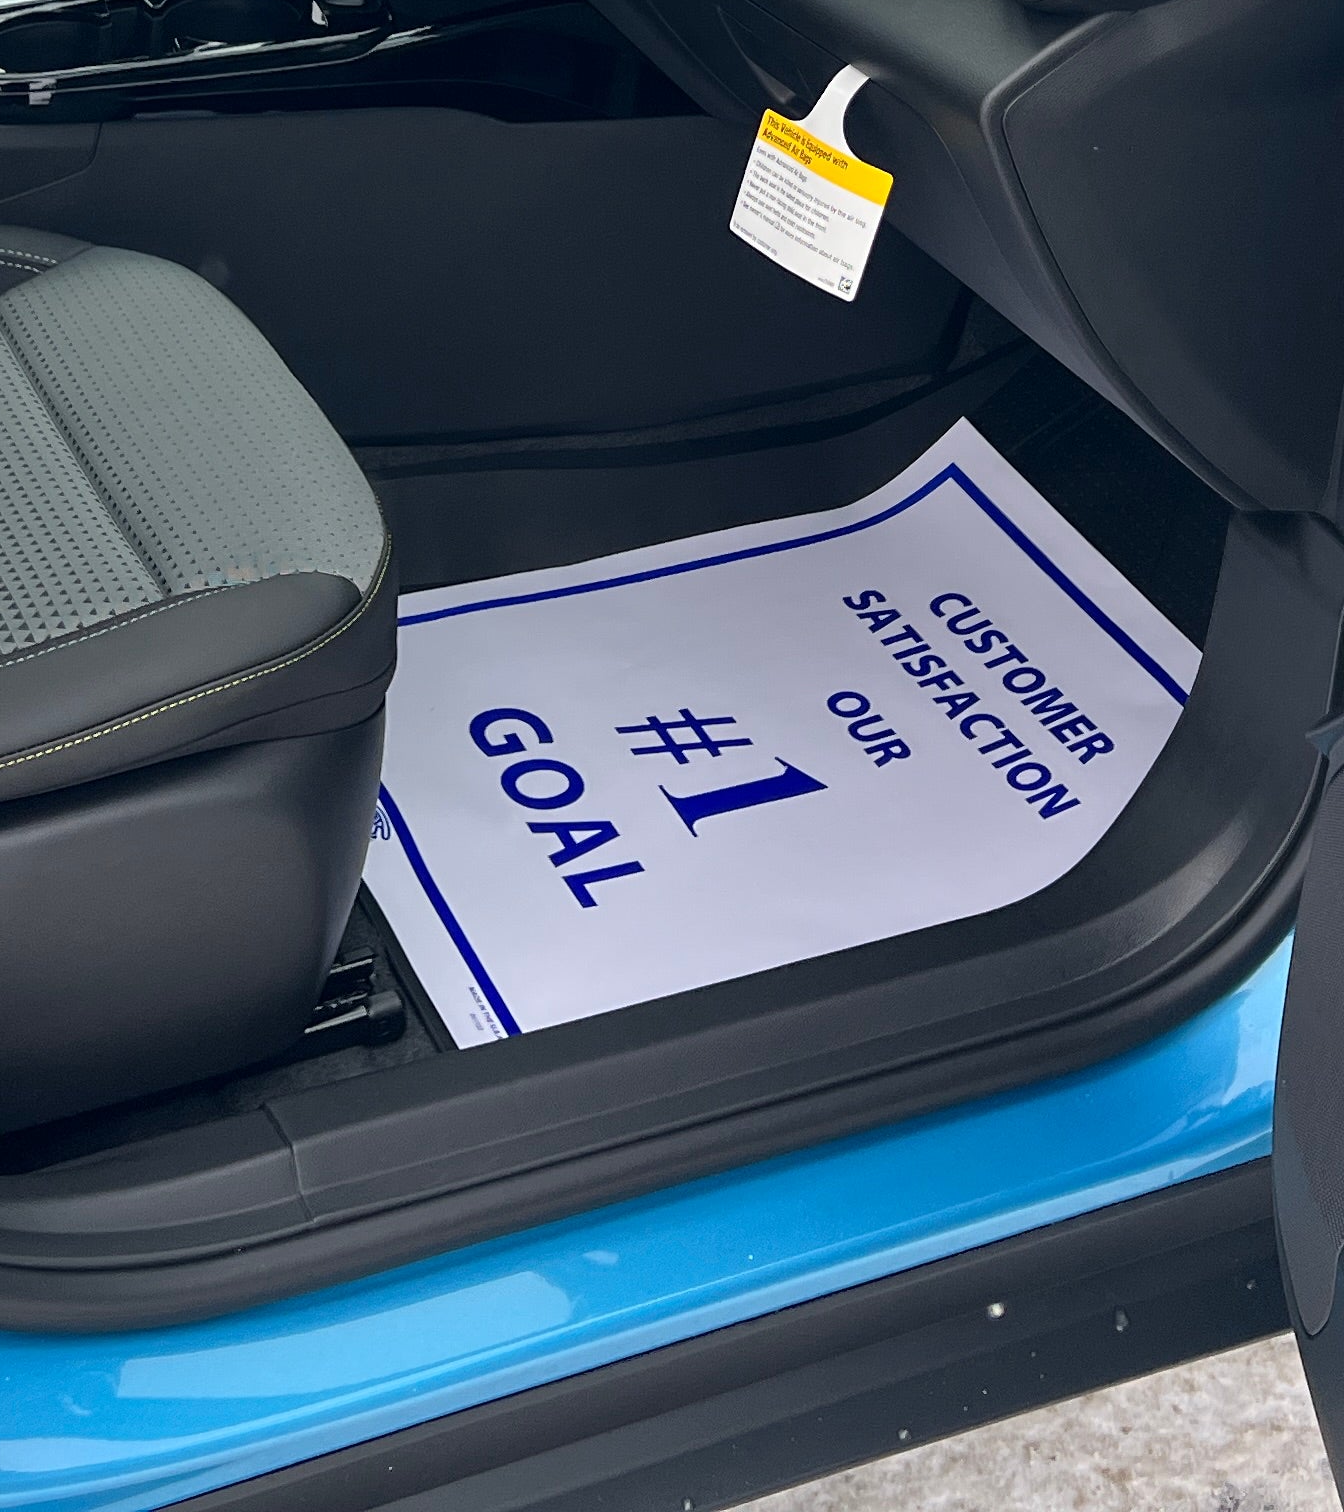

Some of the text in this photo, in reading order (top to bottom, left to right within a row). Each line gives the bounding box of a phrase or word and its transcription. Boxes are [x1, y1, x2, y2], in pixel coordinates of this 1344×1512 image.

[826, 690, 911, 767] OUR
[844, 589, 1081, 819] SATISFACTION
[930, 592, 1114, 764] CUSTOMER
[468, 707, 645, 909] GOAL
[616, 708, 827, 837] #1
